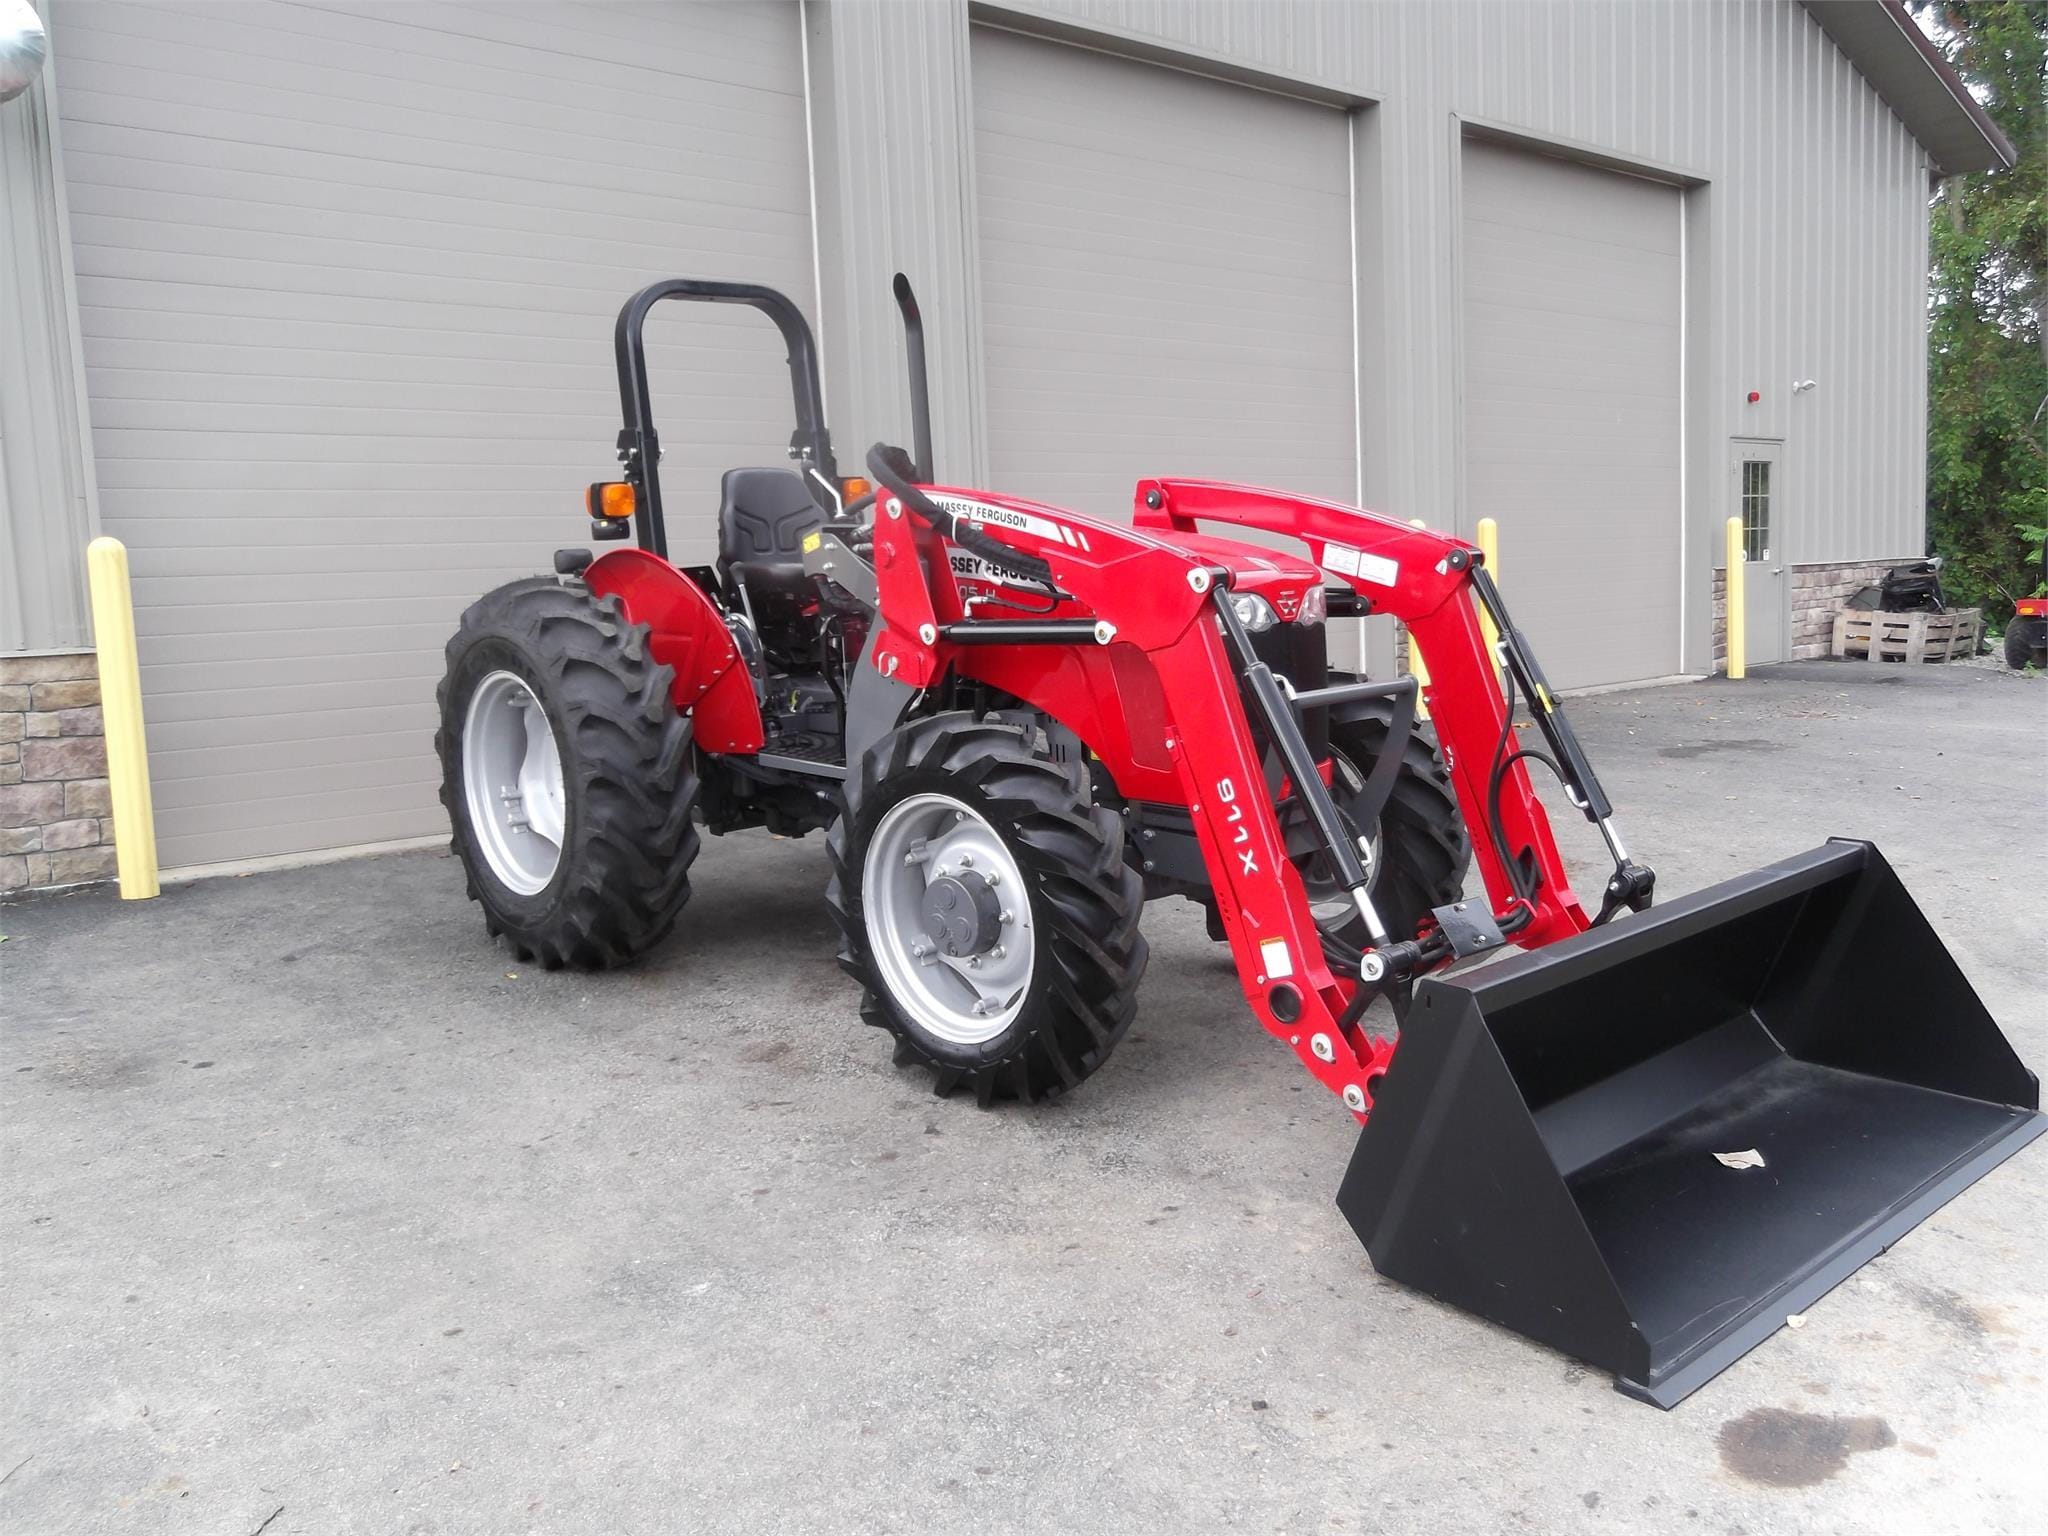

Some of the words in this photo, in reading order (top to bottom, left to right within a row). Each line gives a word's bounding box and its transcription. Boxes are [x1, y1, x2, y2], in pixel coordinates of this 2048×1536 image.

[976, 507, 1028, 528] FERGUSON
[950, 556, 981, 574] SSEY
[1216, 777, 1259, 876] 911X
